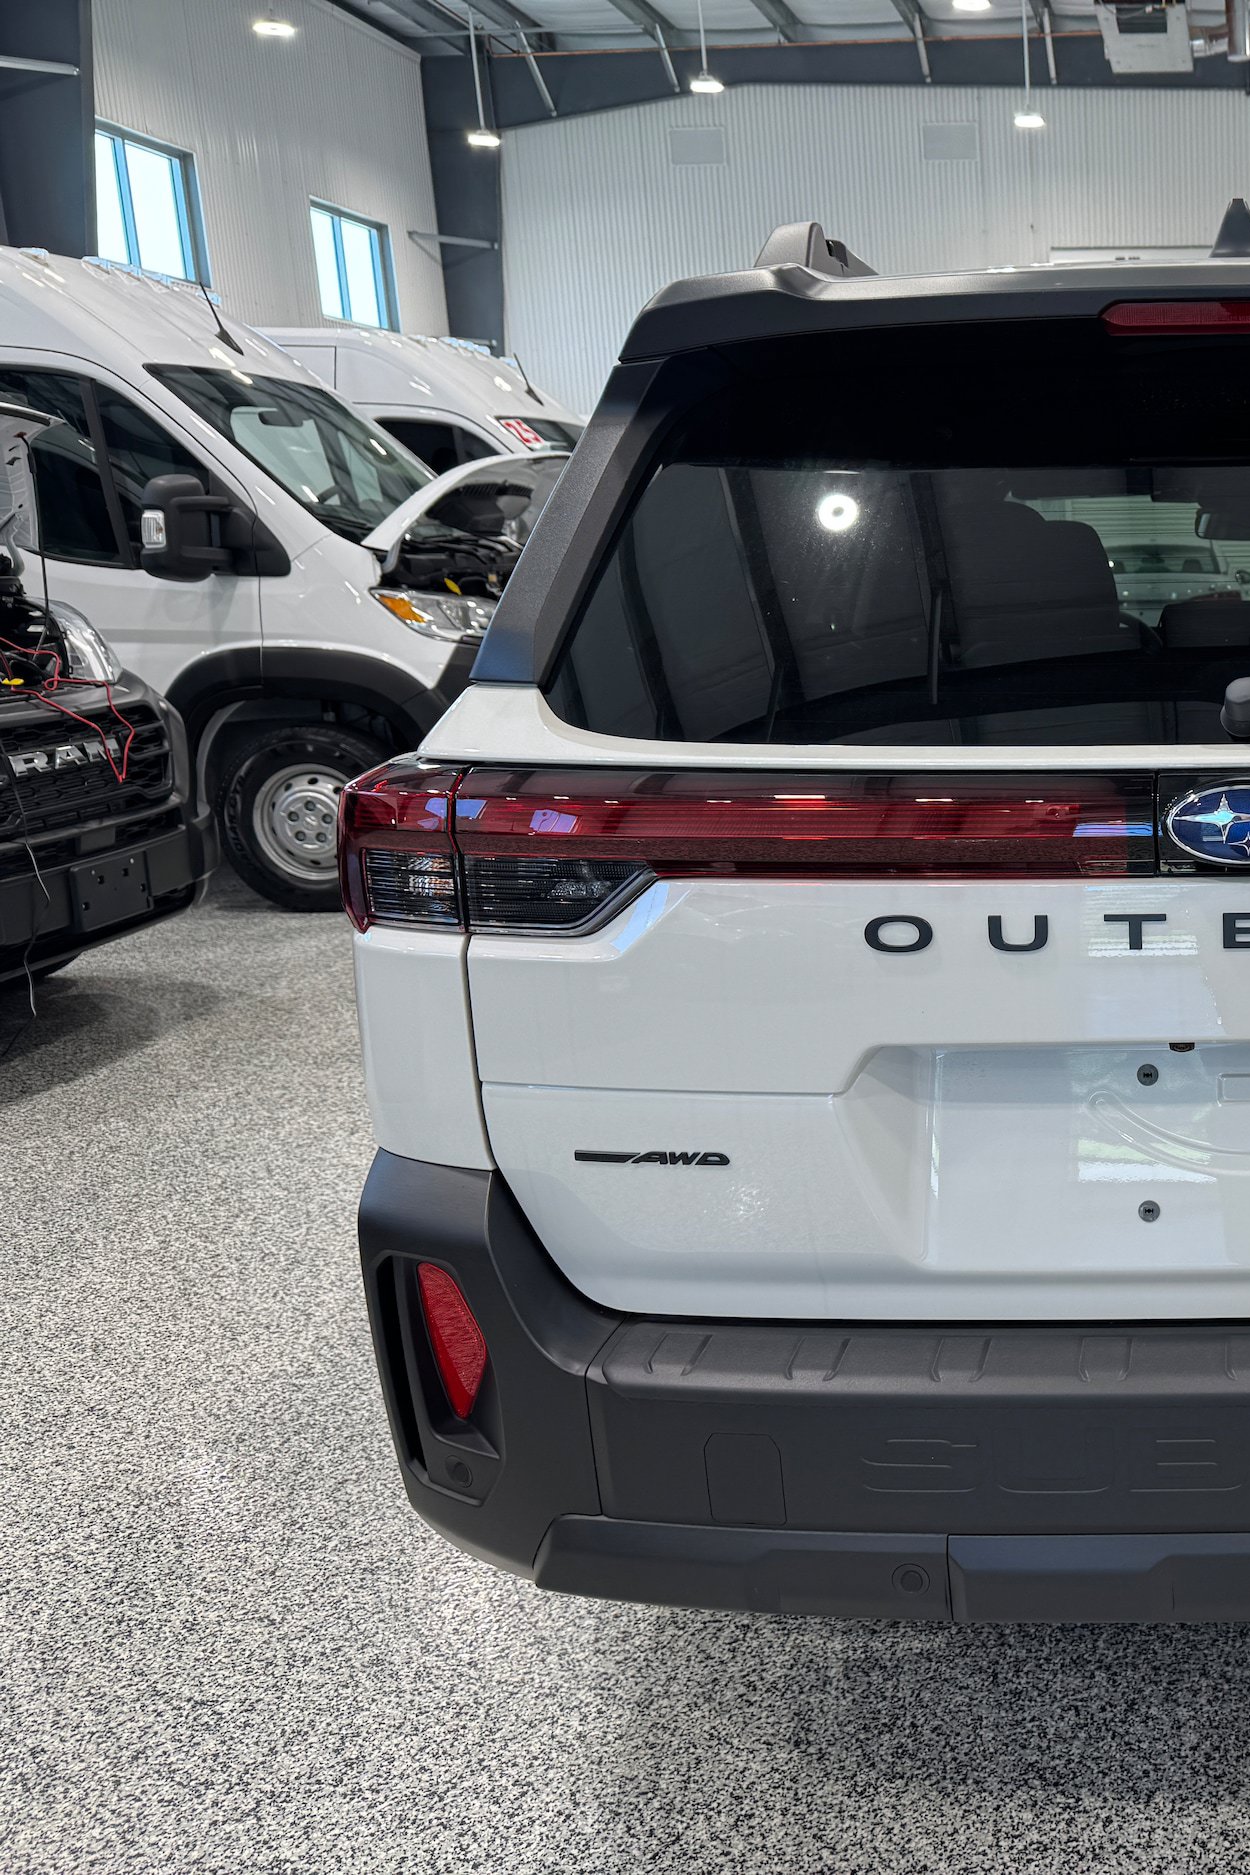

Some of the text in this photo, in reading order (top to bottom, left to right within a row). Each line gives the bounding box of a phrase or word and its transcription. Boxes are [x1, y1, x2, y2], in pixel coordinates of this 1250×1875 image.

[503, 419, 544, 445] 25
[8, 738, 120, 777] RAM
[631, 1151, 730, 1166] AWD
